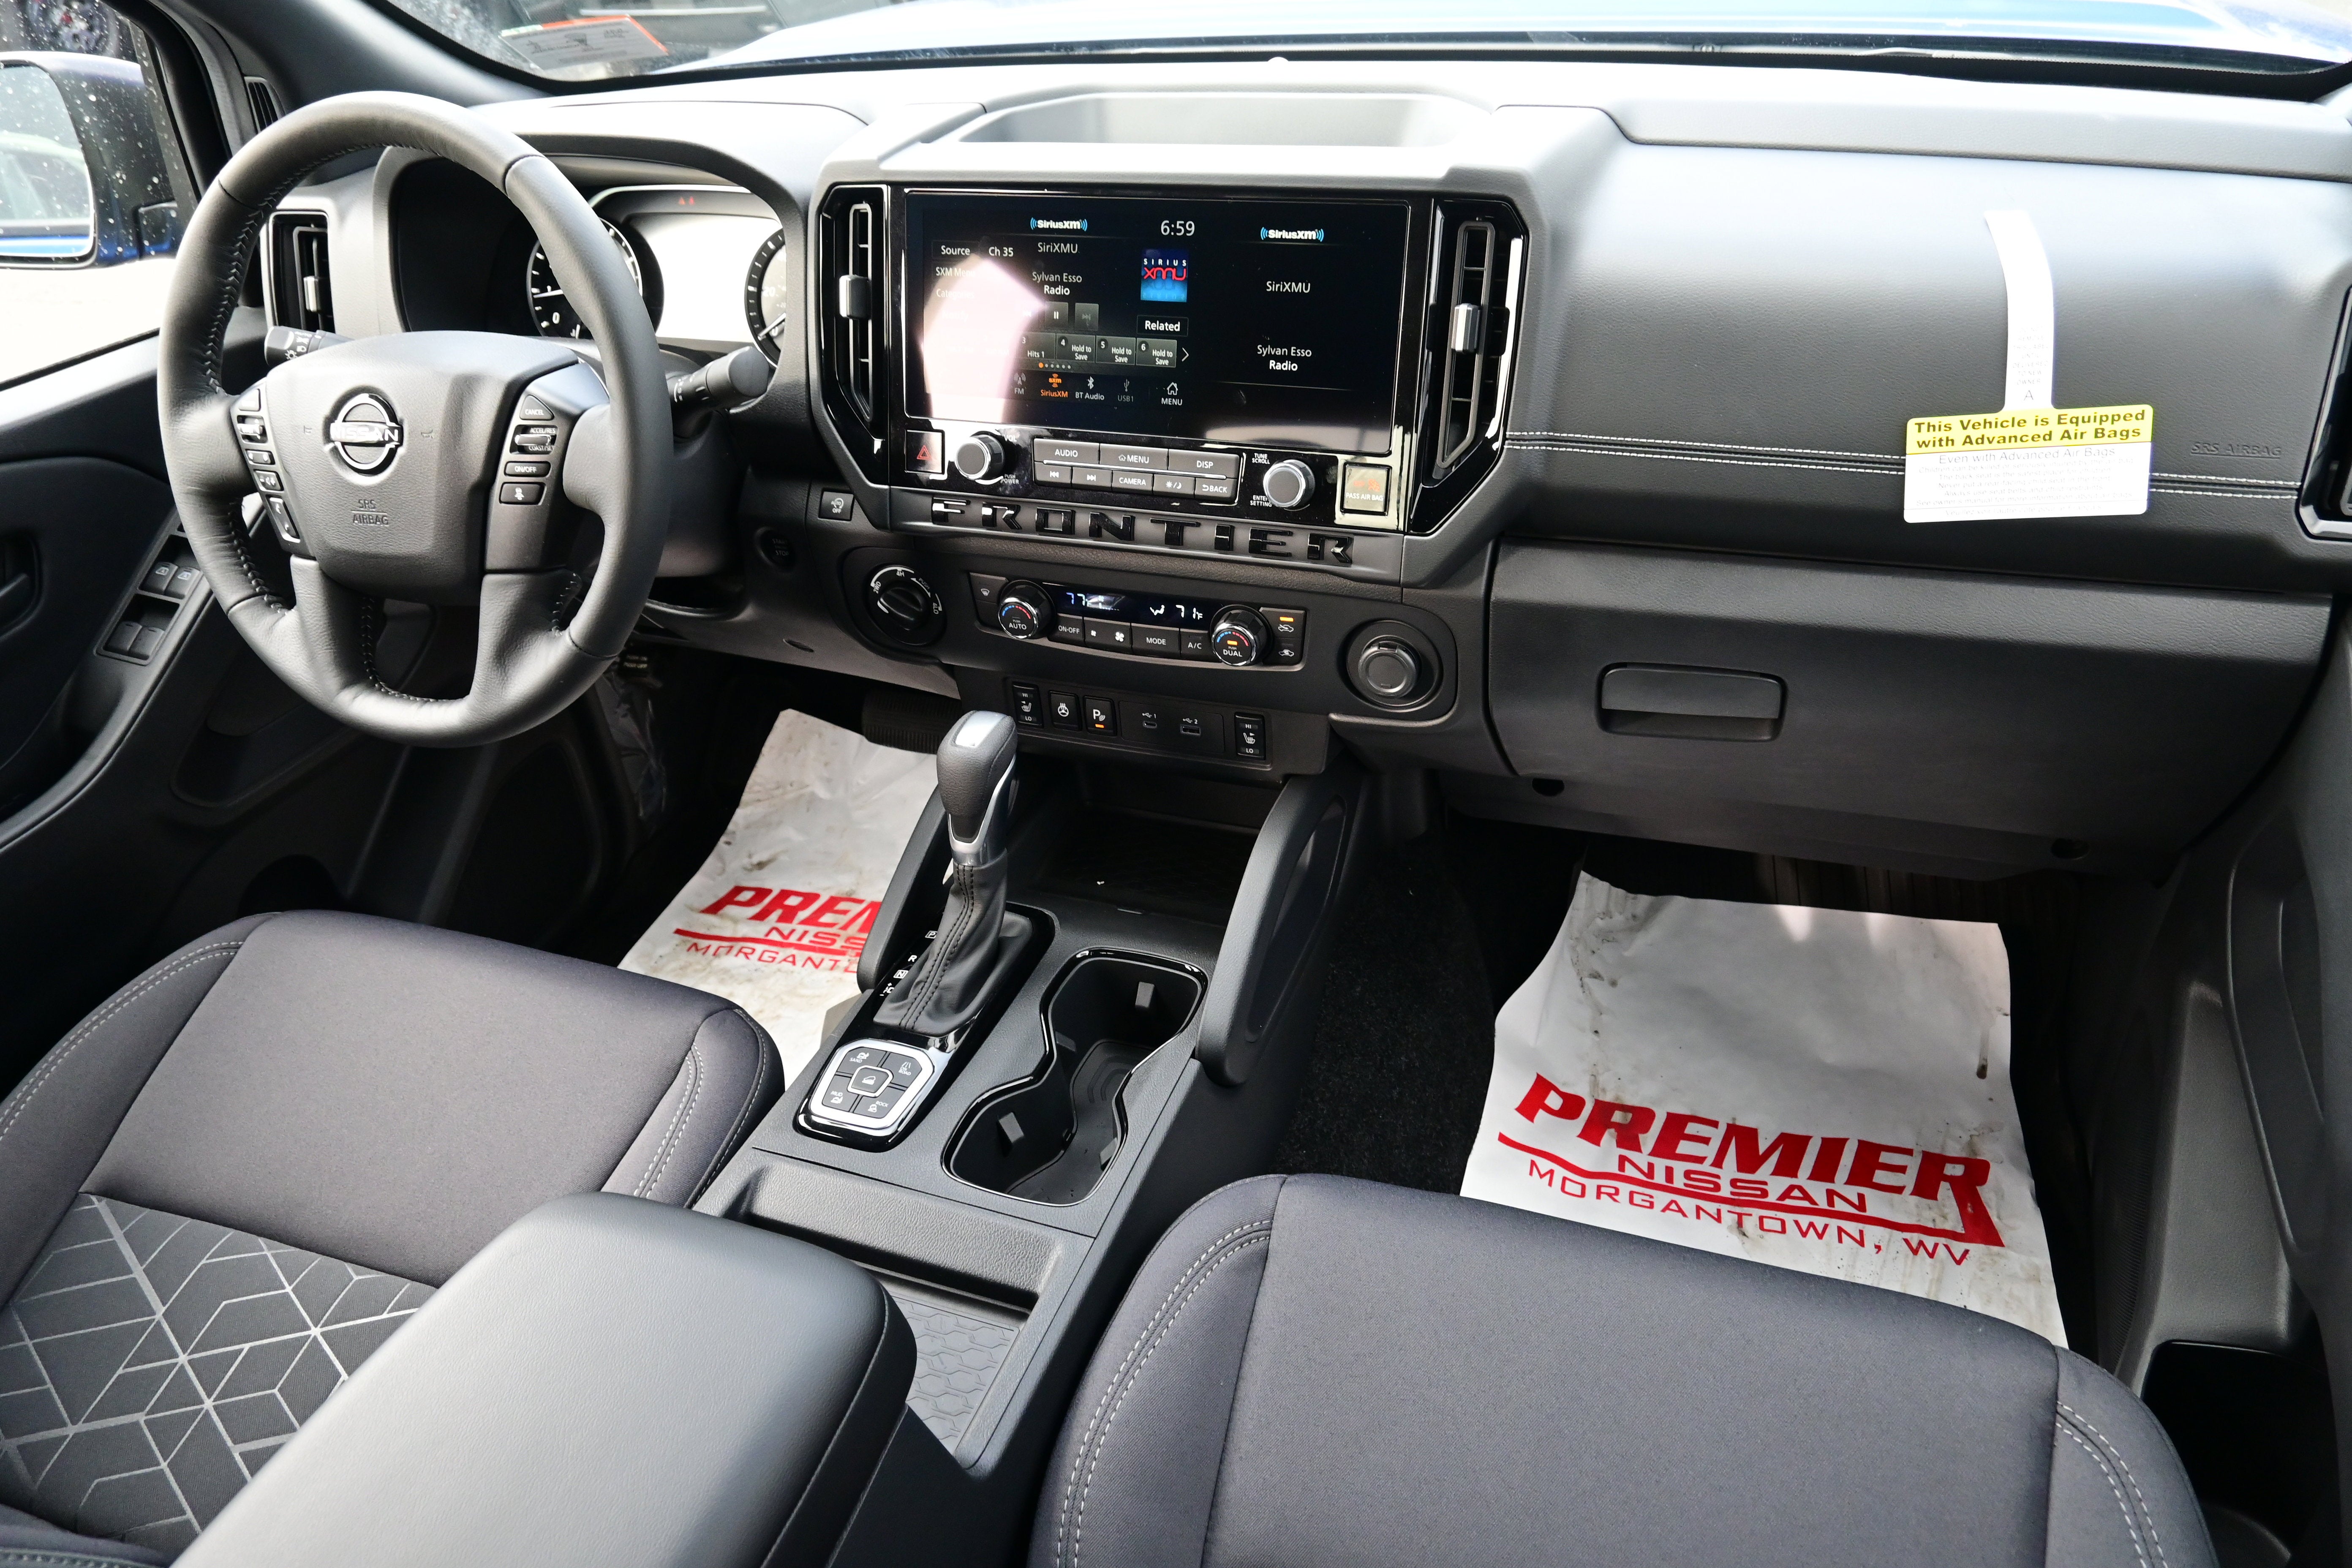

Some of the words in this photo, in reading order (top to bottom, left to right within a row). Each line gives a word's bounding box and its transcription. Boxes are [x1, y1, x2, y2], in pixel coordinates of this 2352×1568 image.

[1161, 220, 1195, 236] 6:59
[942, 245, 970, 256] Source
[989, 247, 1000, 256] Ch
[1003, 248, 1013, 256] 35
[1037, 242, 1078, 254] SiriXMU
[1143, 258, 1187, 267] SIRIUS
[936, 267, 952, 276] SXM
[1032, 272, 1060, 284] Sylvan
[1062, 273, 1082, 283] Esso
[1044, 286, 1070, 296] Radio
[1266, 281, 1310, 293] SiriXMU
[553, 312, 560, 324] 0
[1145, 321, 1181, 332] Related
[1152, 349, 1165, 357] Hold
[1257, 345, 1288, 357] Sylvan
[1291, 347, 1312, 357] Esso
[1075, 353, 1088, 361] Save
[1115, 355, 1128, 363] Save
[1269, 360, 1298, 371] Radio
[1040, 389, 1068, 398] SiriusXM
[1085, 392, 1105, 400] Audio
[1162, 397, 1183, 406] MENU
[1915, 422, 1952, 433] This
[1960, 417, 2027, 431] Vehicle
[2035, 416, 2049, 426] is
[2058, 410, 2145, 427] Equipped
[331, 427, 399, 441] NISSAN
[1917, 436, 1955, 449] with
[1962, 431, 2052, 446] Advanced
[2061, 429, 2087, 441] Air
[2095, 427, 2141, 441] Bags
[2191, 442, 2219, 452] SRS
[2226, 444, 2281, 456] AIRBAG
[1127, 455, 1149, 464] MENU
[1939, 455, 1968, 464] Even
[1973, 453, 1995, 462] with
[2000, 449, 2059, 460] Advanced
[2063, 448, 2080, 457] Air
[2085, 447, 2115, 458] Bags
[1197, 460, 1213, 469] DISP
[1119, 477, 1146, 486] CAMERA
[1209, 485, 1227, 493] BACK
[359, 499, 376, 509] SRS
[353, 515, 389, 525] AIRBAG
[932, 497, 1352, 563] FRONTIER
[873, 581, 882, 594] 2WD
[918, 577, 930, 590] PUSH
[1146, 637, 1166, 645] MODE
[1223, 649, 1242, 657] DUAL
[1515, 1073, 2005, 1247] PREMIER
[1618, 1154, 1867, 1213] NISSAN
[1528, 1159, 1882, 1255] MORGANTOWN,
[1902, 1237, 1970, 1266] WV
